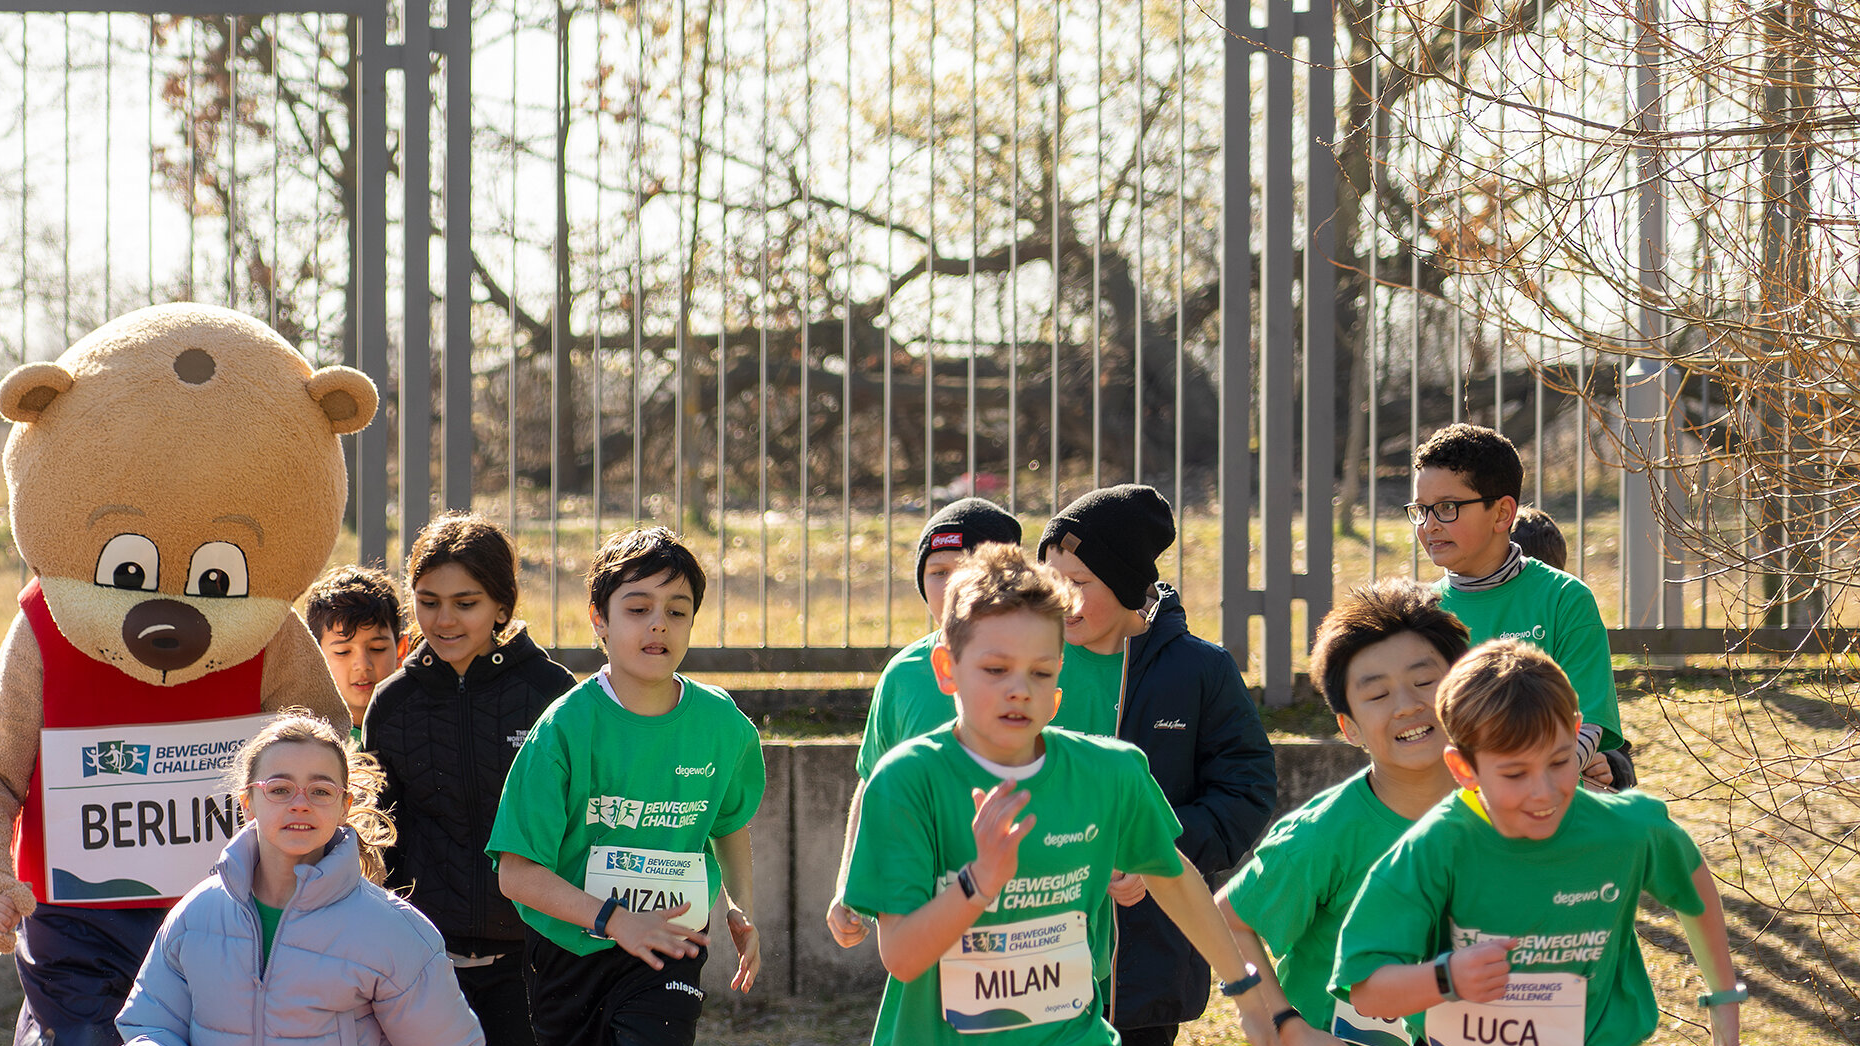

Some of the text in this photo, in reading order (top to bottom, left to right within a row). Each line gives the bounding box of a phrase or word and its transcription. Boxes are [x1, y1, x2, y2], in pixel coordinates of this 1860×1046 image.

[675, 765, 704, 777] degewo
[644, 800, 709, 815] BEWEGUNGS
[641, 813, 698, 828] CHALLENGE
[1044, 832, 1084, 848] degewo
[647, 858, 691, 868] BEWEGUNGS
[645, 867, 685, 876] CHALLENGE
[1005, 865, 1091, 893] BEWEGUNGS
[1003, 883, 1082, 910] CHALLENGE
[1553, 891, 1598, 906] degewo
[1010, 923, 1068, 941] BEWEGUNGS
[1009, 935, 1061, 951] CHALLENGE
[1511, 947, 1604, 965] CHALLENGE
[975, 961, 1060, 1000] MILAN
[1504, 982, 1563, 992] EWEGUNGS
[1500, 992, 1554, 1001] HALLENGE
[1044, 1003, 1071, 1013] degewo
